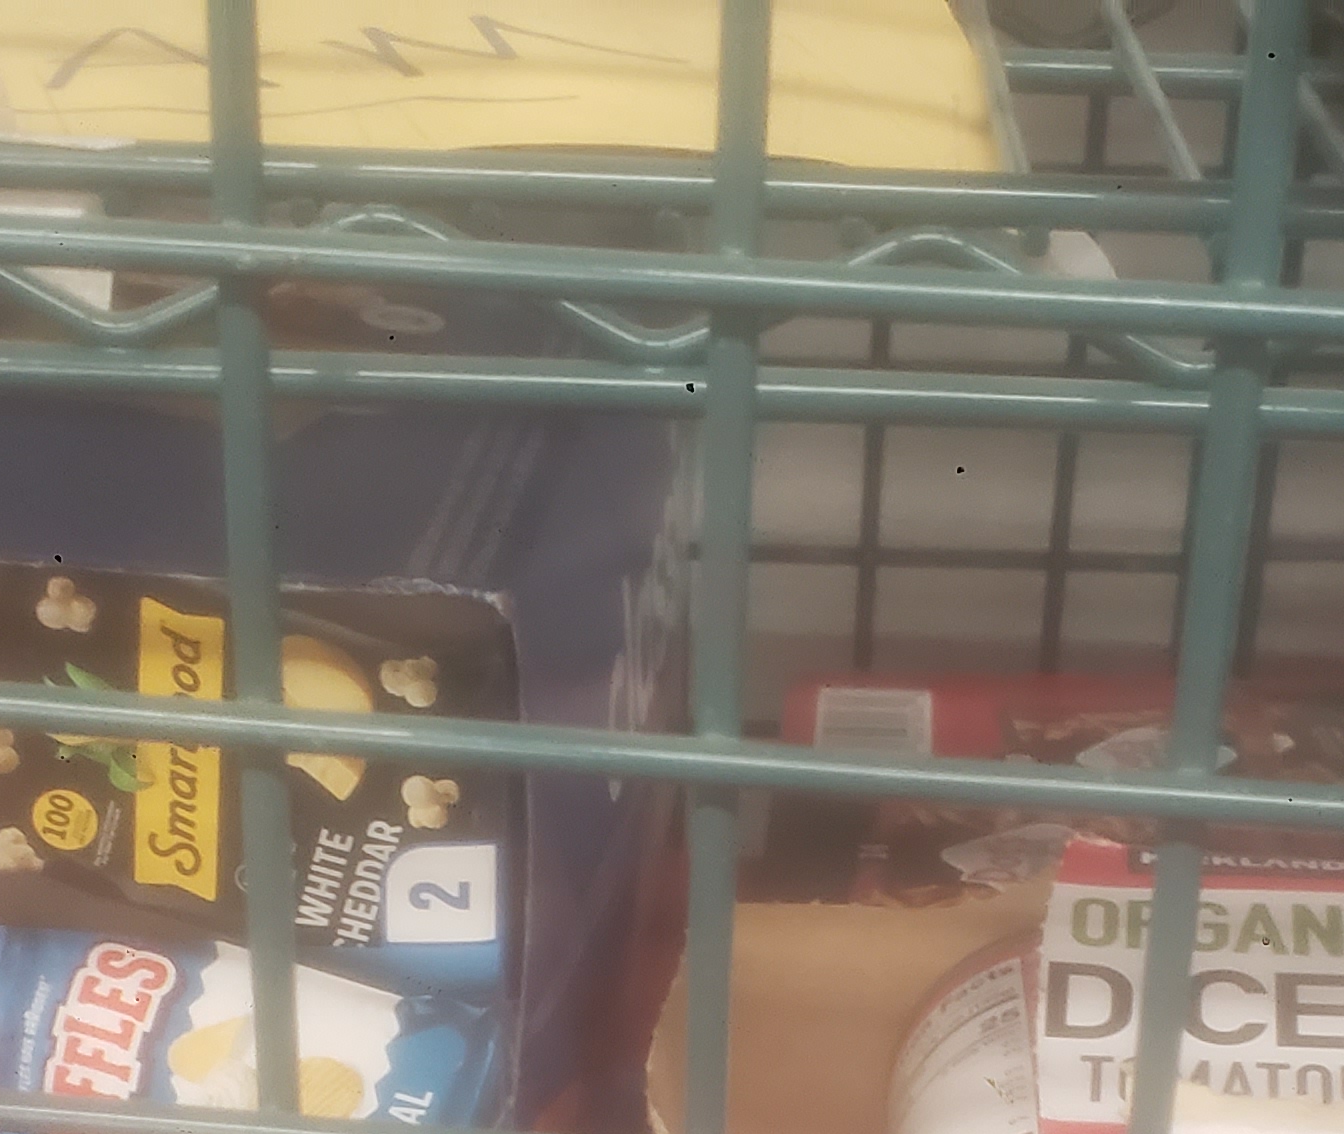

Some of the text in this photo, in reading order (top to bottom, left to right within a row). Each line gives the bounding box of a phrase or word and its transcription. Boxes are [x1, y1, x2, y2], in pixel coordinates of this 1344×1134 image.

[148, 622, 202, 878] Smarod
[43, 794, 74, 841] 100
[295, 829, 354, 928] WHITE
[410, 880, 470, 911] 2
